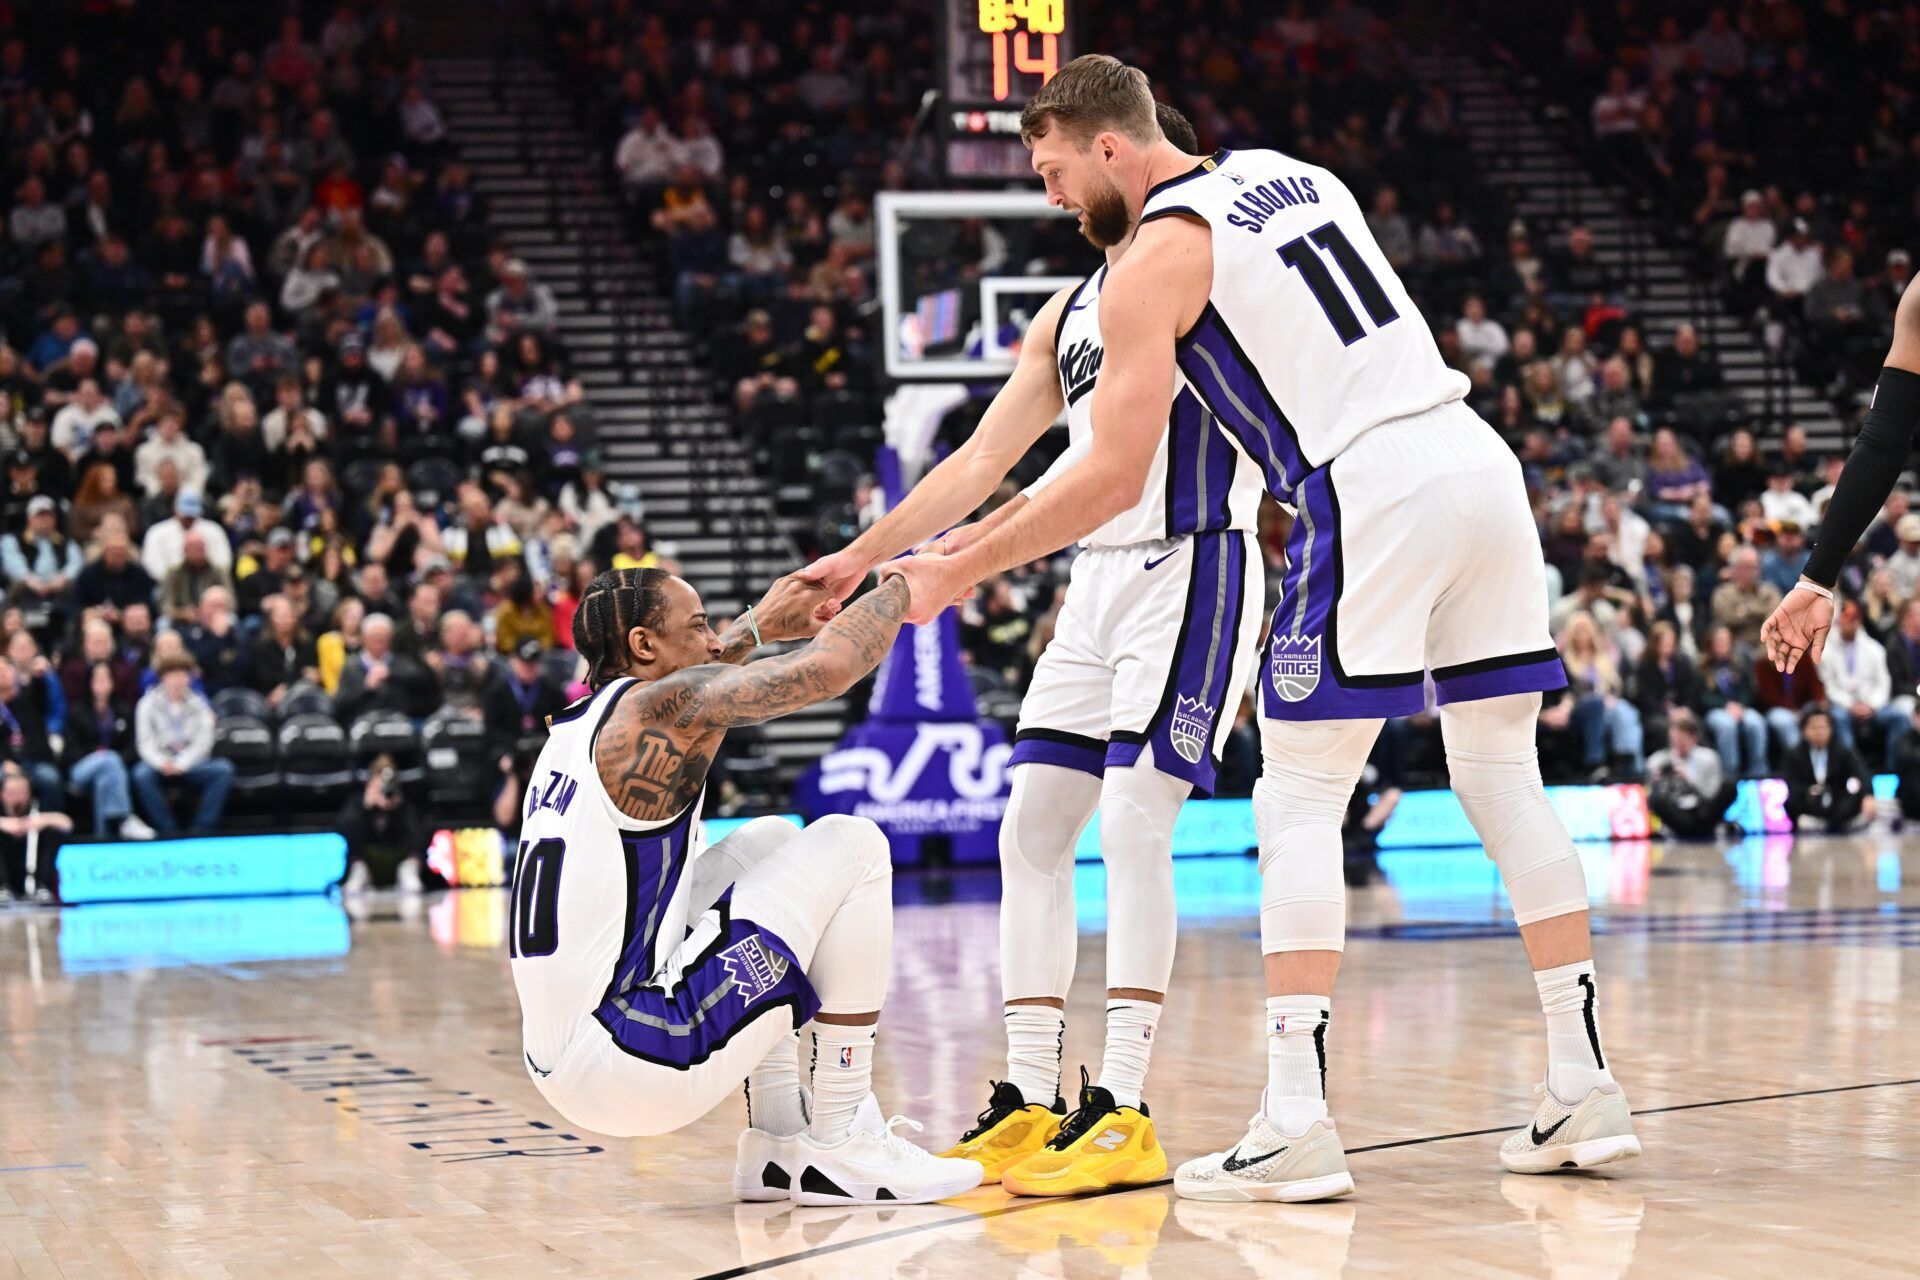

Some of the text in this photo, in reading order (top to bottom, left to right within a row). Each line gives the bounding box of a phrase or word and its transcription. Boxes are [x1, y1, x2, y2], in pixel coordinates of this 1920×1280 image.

[992, 31, 1058, 102] 14
[1226, 176, 1320, 234] SABONIS
[1275, 220, 1400, 348] 11
[1060, 337, 1104, 396] Kin
[1272, 661, 1319, 676] KINGS
[1273, 653, 1318, 661] SACRAMENTO
[741, 937, 776, 990] KINGS
